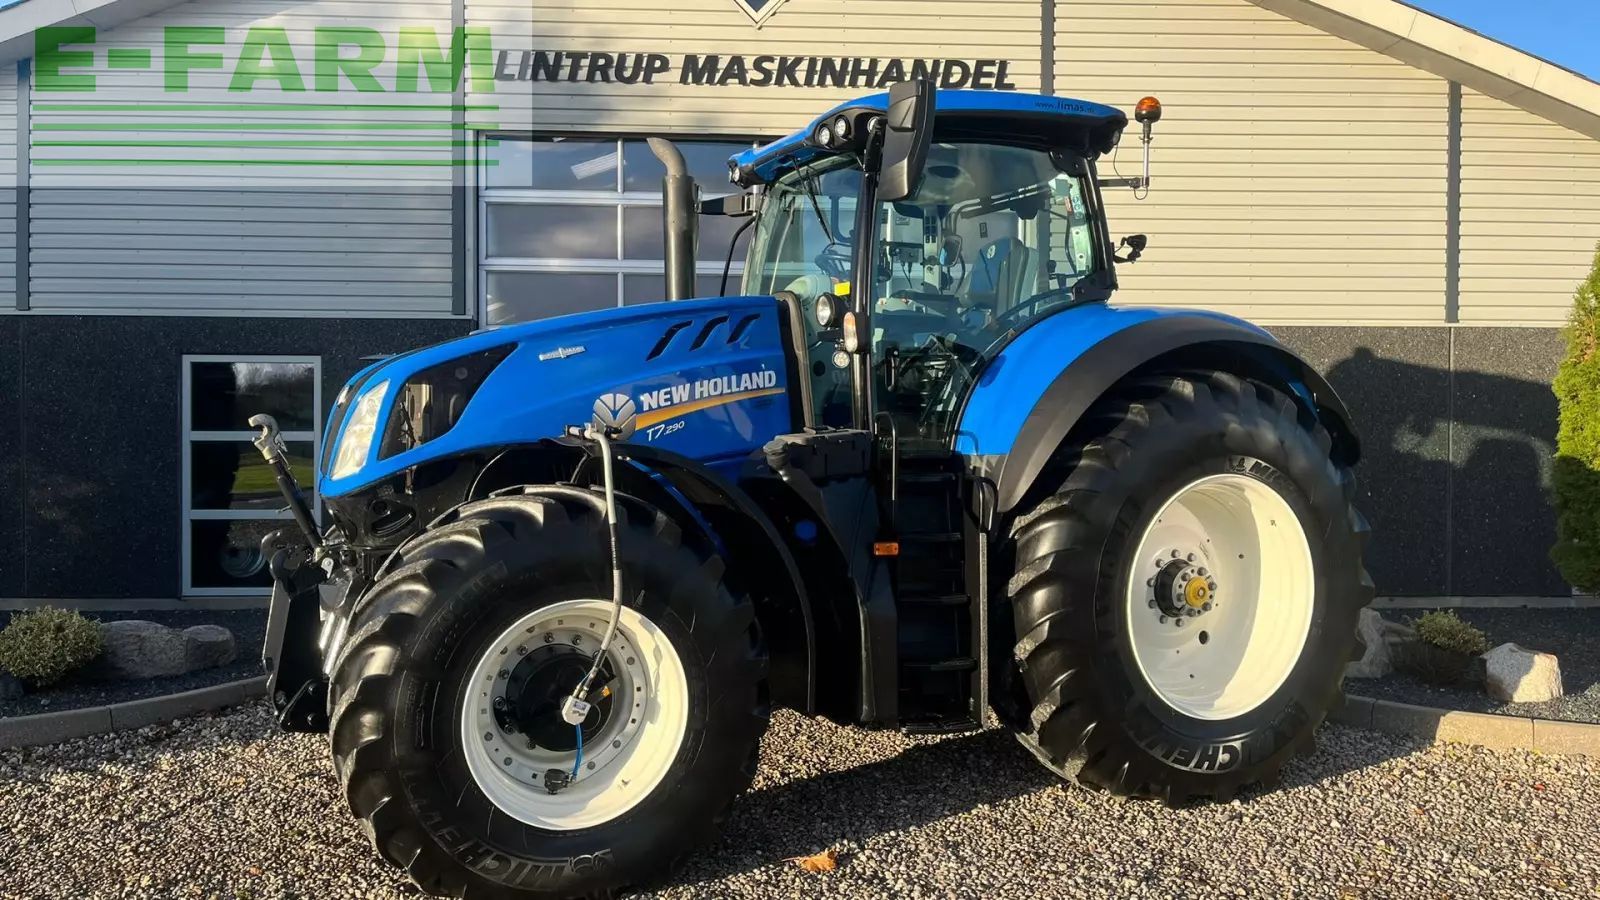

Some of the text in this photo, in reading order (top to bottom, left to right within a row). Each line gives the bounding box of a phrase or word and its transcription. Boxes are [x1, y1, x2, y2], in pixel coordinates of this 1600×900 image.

[494, 50, 1015, 91] LINTRUP MASKINHANDEL
[640, 370, 776, 411] NEW HOLLAND
